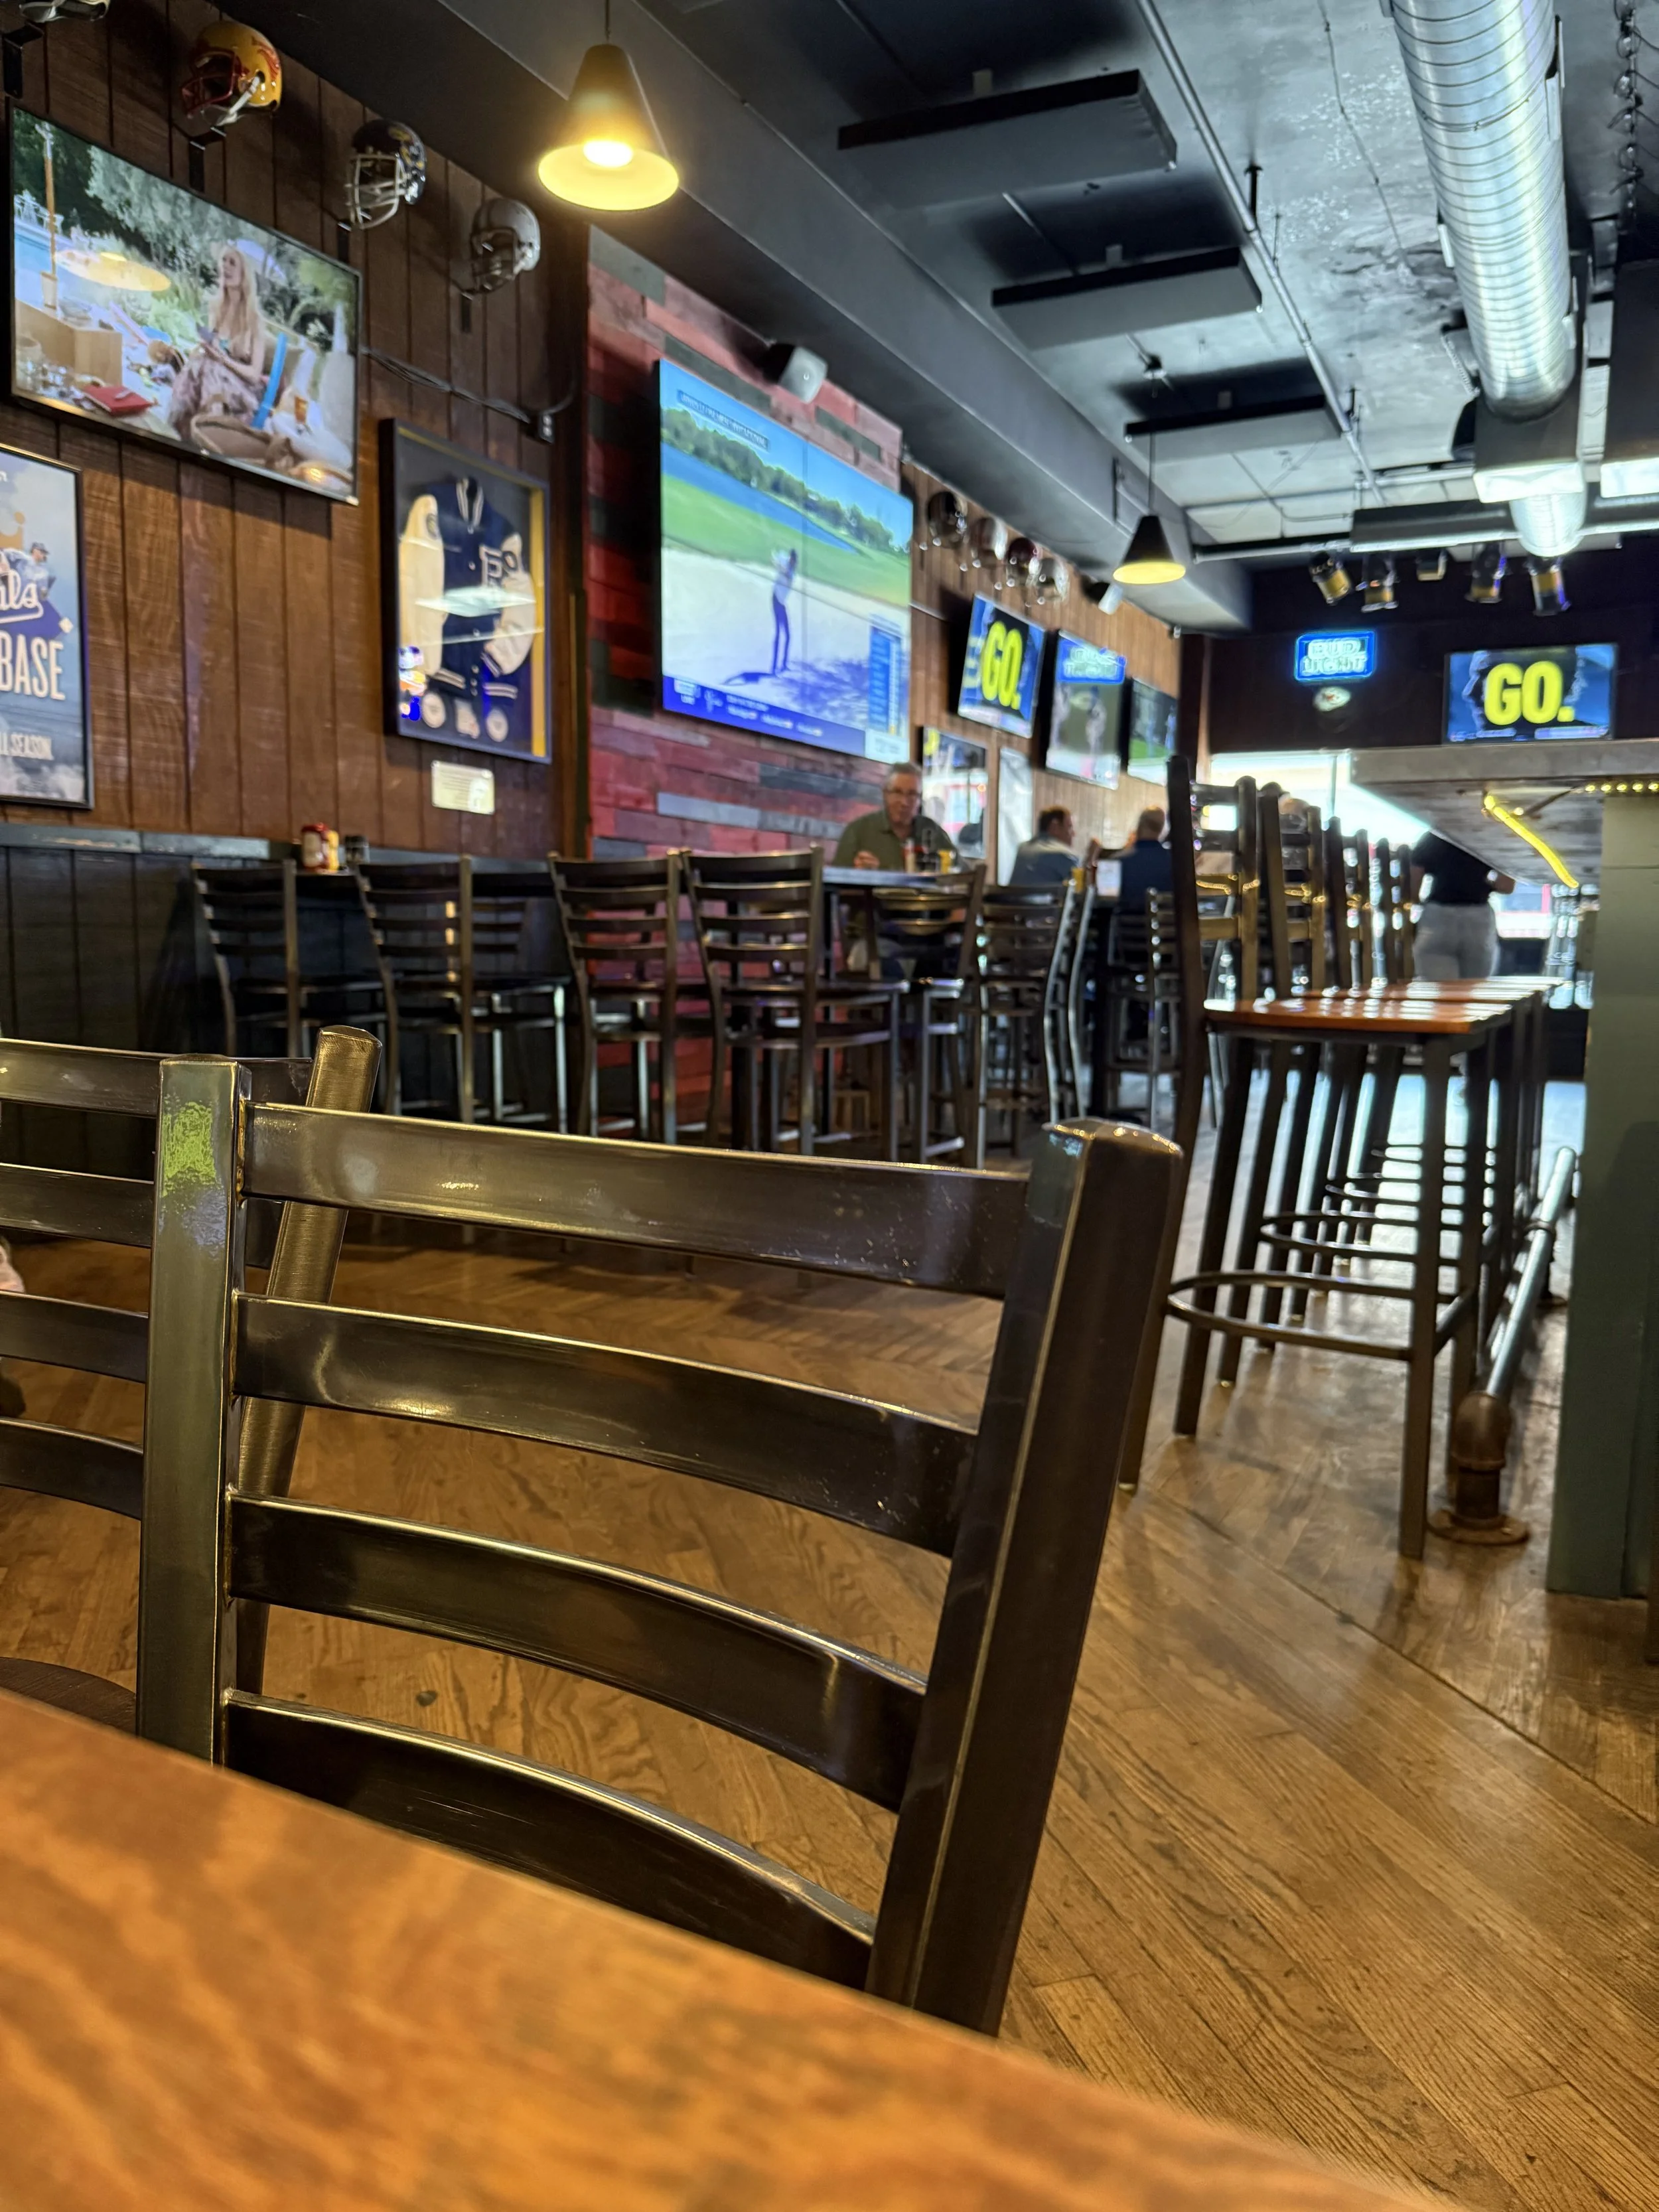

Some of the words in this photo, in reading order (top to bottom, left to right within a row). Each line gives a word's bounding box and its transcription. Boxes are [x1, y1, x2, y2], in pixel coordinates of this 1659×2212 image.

[0, 630, 66, 701] BASE
[982, 621, 1023, 711] GO.
[1307, 638, 1361, 660] BUD
[1484, 660, 1575, 725] GO.
